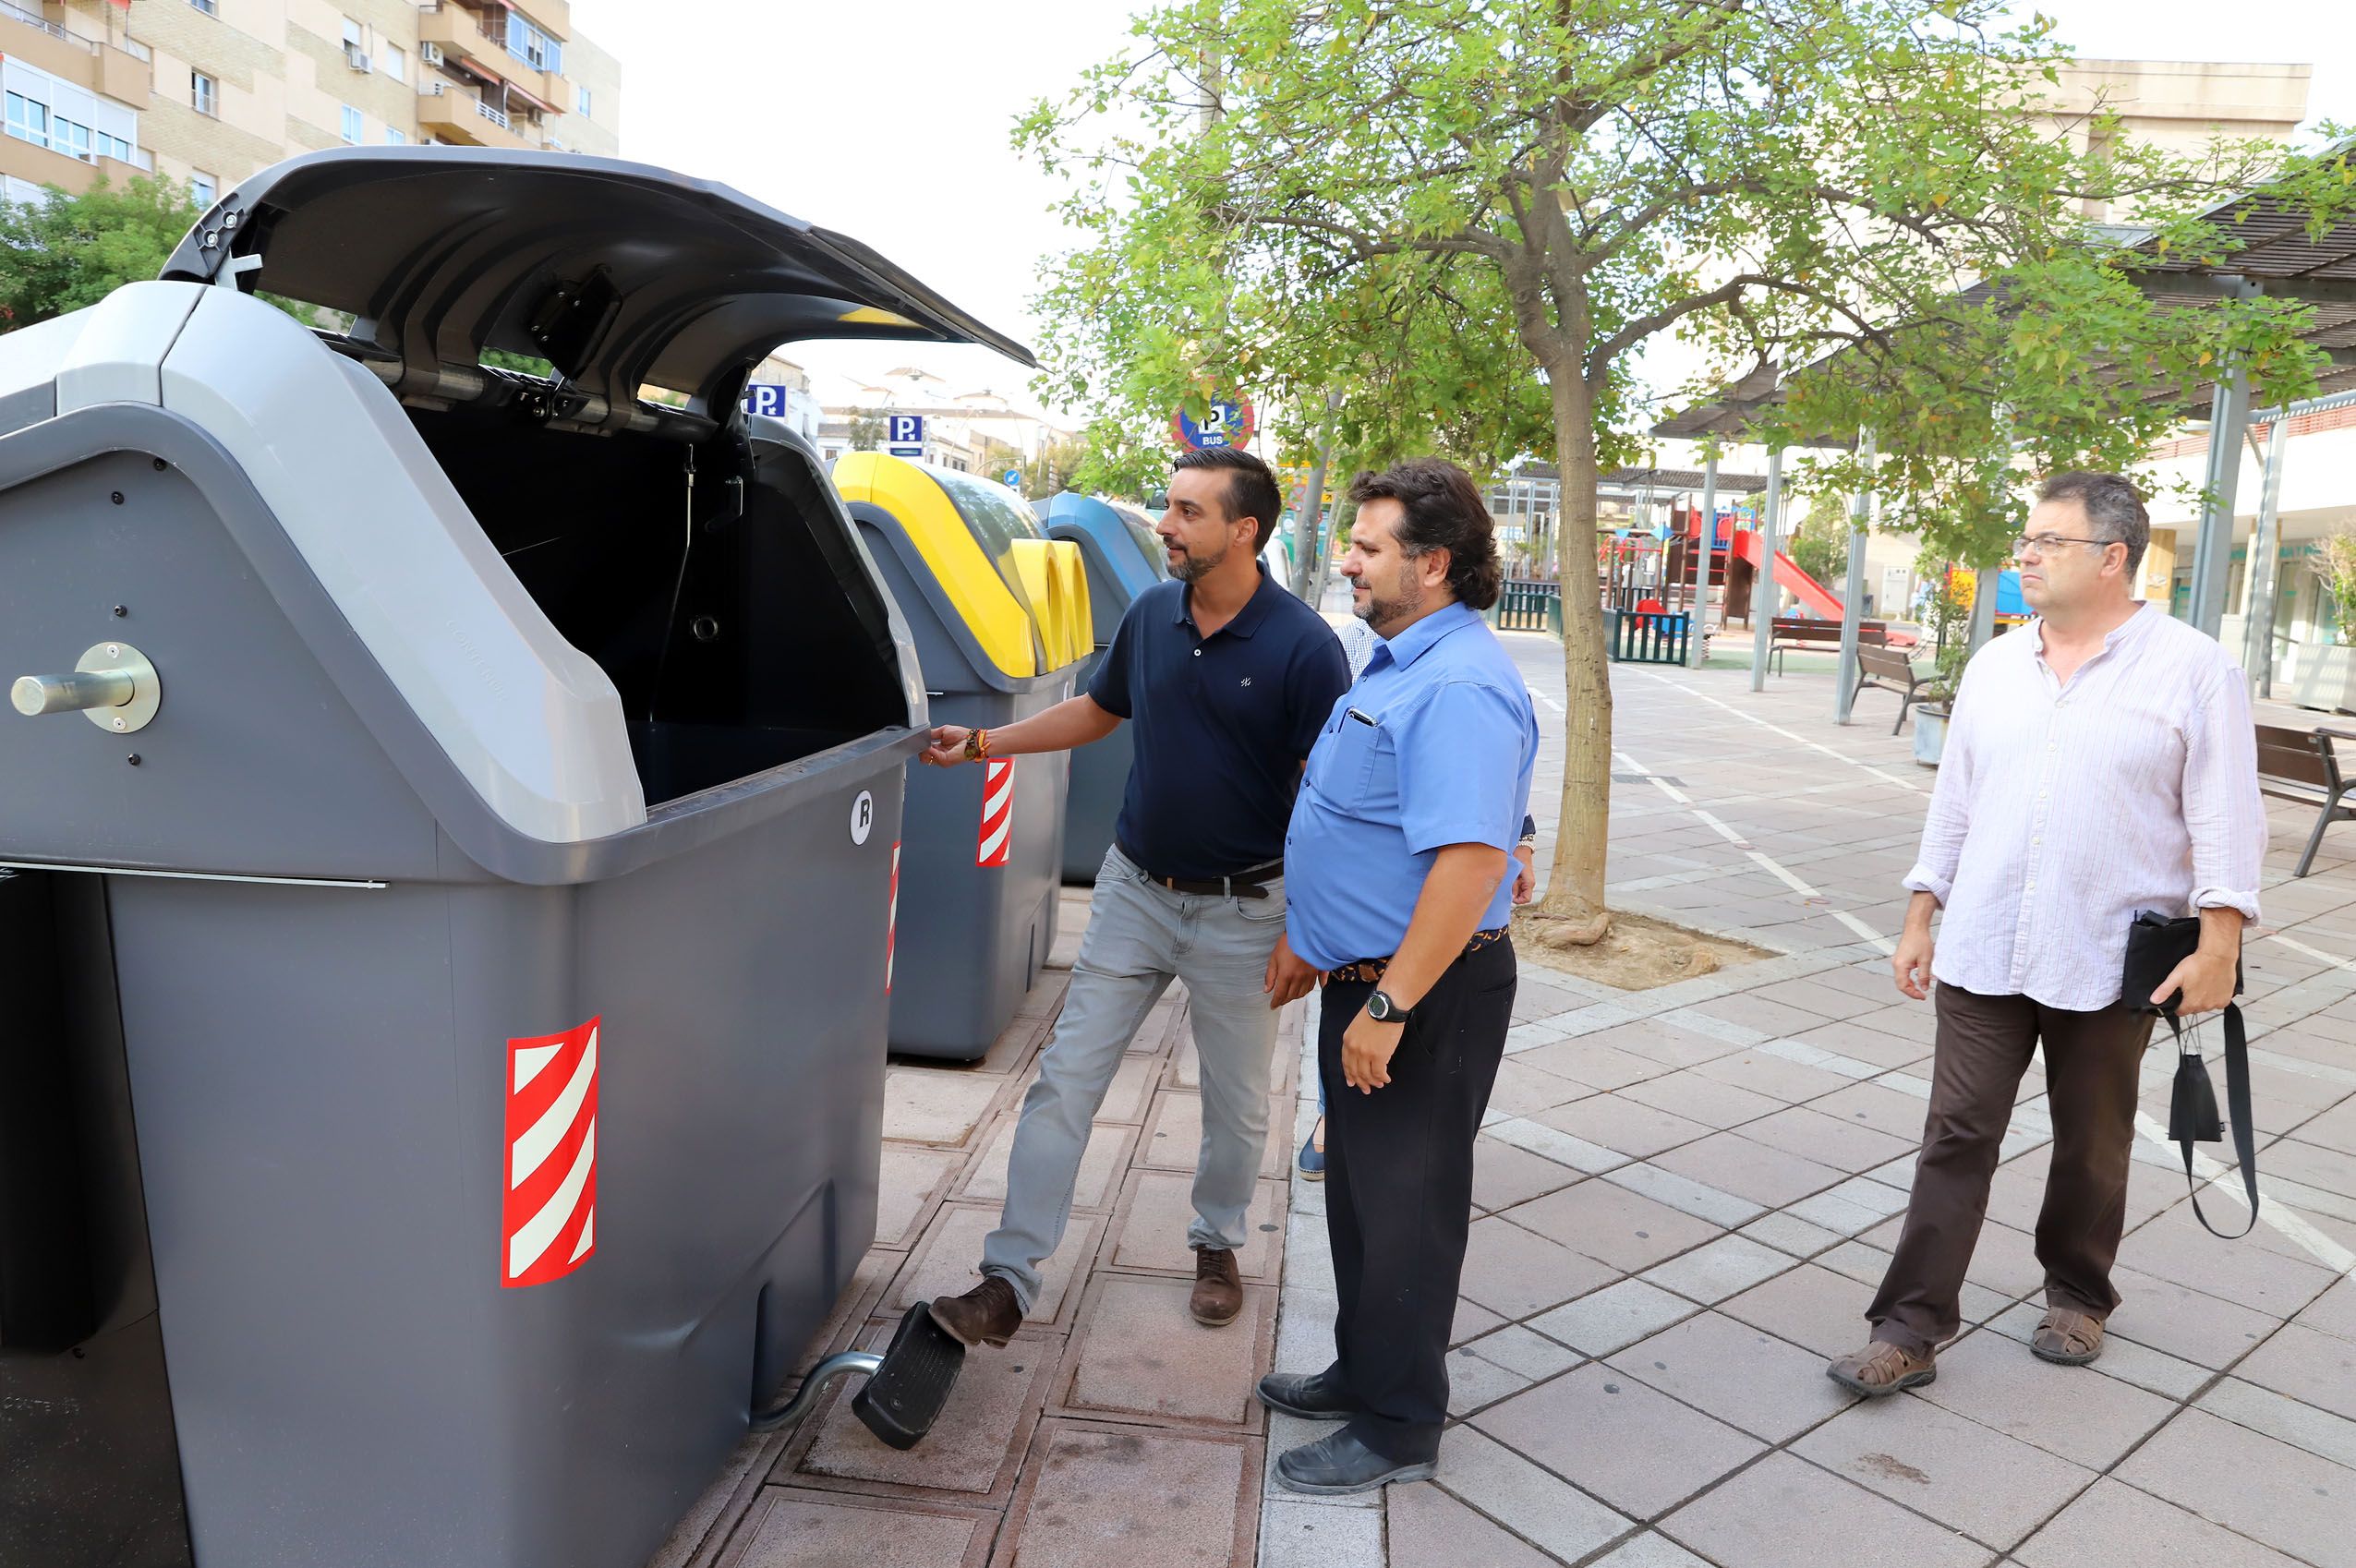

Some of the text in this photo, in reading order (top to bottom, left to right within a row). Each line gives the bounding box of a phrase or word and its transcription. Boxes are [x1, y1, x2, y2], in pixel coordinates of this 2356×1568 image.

[755, 387, 777, 415] P
[897, 416, 915, 440] P
[1202, 436, 1223, 445] BUS
[860, 799, 870, 827] R
